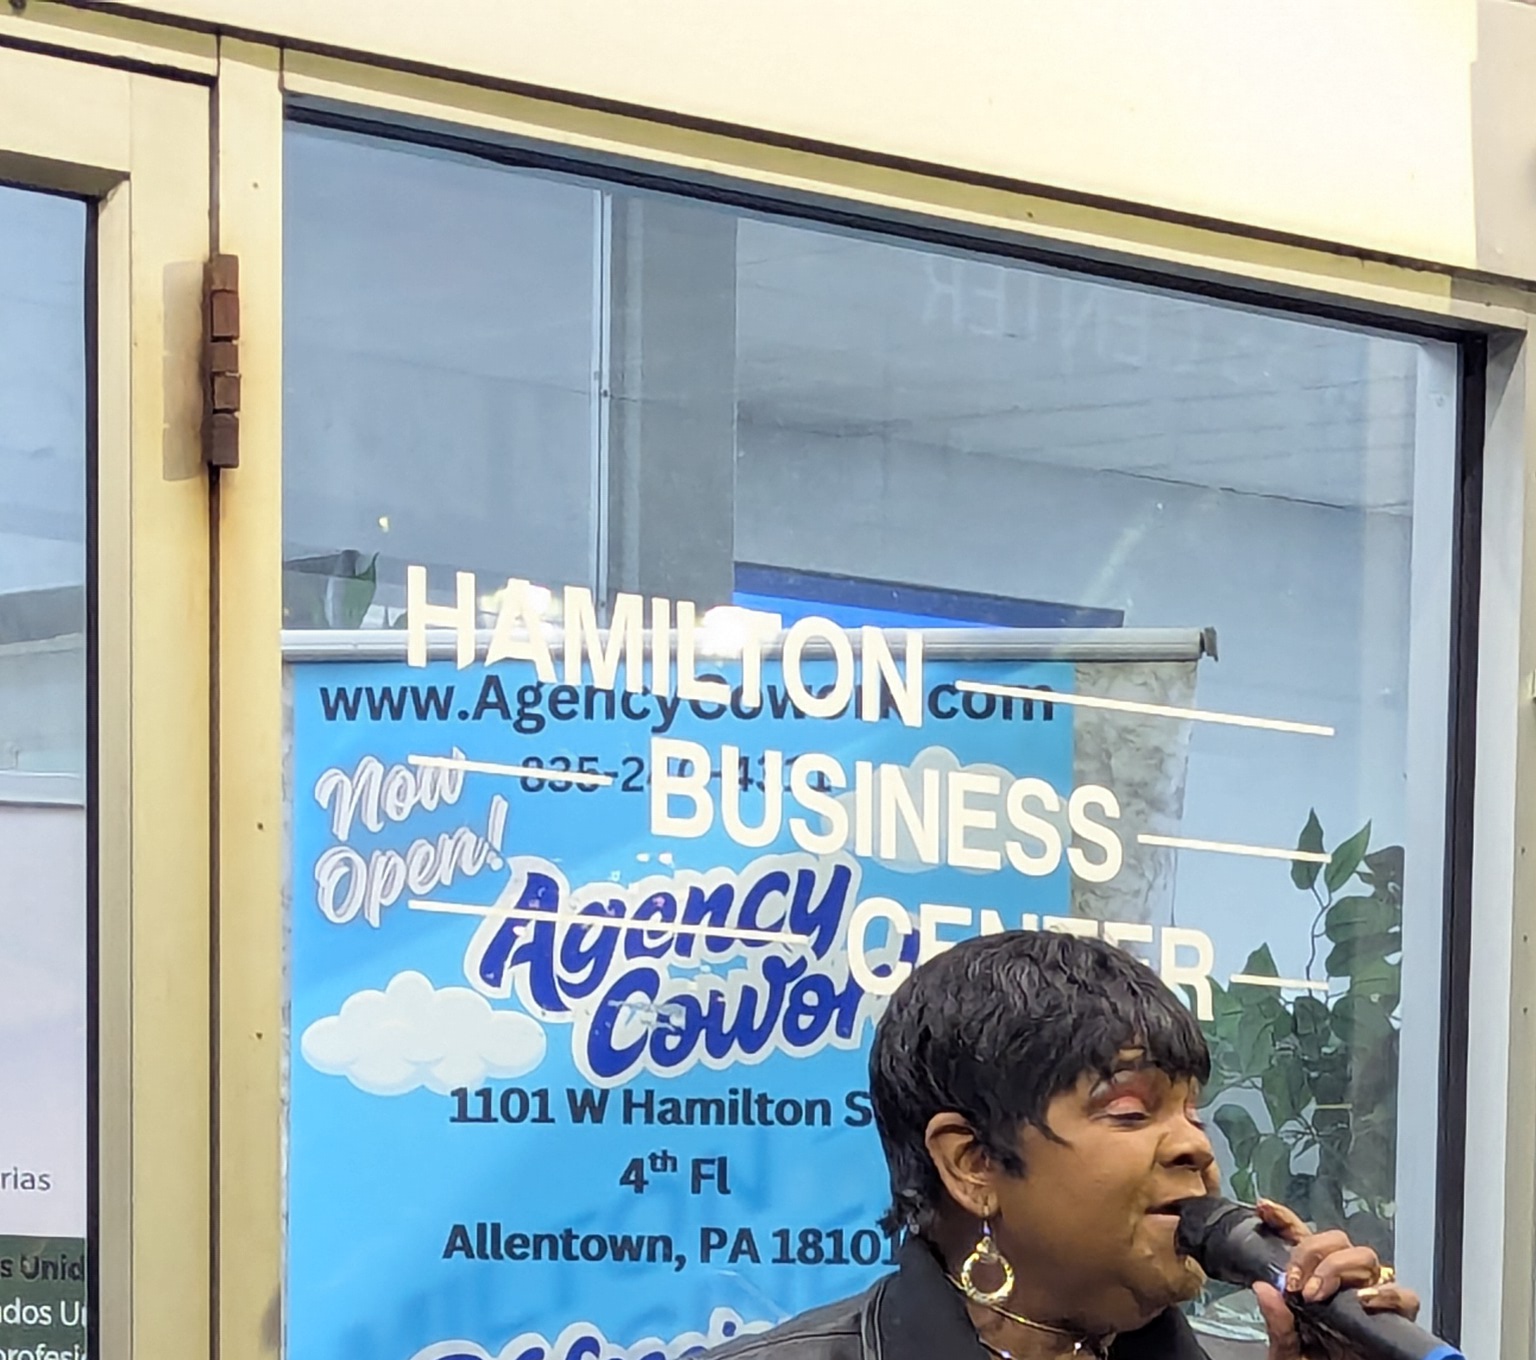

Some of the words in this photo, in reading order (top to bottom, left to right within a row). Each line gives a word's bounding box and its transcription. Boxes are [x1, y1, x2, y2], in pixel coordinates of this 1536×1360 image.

[407, 565, 925, 729] HAMILTON
[313, 745, 468, 842] Now
[649, 735, 1123, 882] BUSINESS
[313, 793, 509, 929] Open!
[477, 862, 853, 1014] Agency
[847, 896, 1215, 1022] CER
[448, 1086, 555, 1124] 1101
[566, 1087, 609, 1125] W
[622, 1087, 832, 1127] Hamilton
[843, 1092, 873, 1128] S
[0, 1165, 52, 1192] rias
[618, 1149, 678, 1194] 4th
[689, 1156, 732, 1195] Fl
[441, 1222, 687, 1272] Allentown,
[700, 1227, 762, 1264] PA
[771, 1227, 901, 1266] 18101
